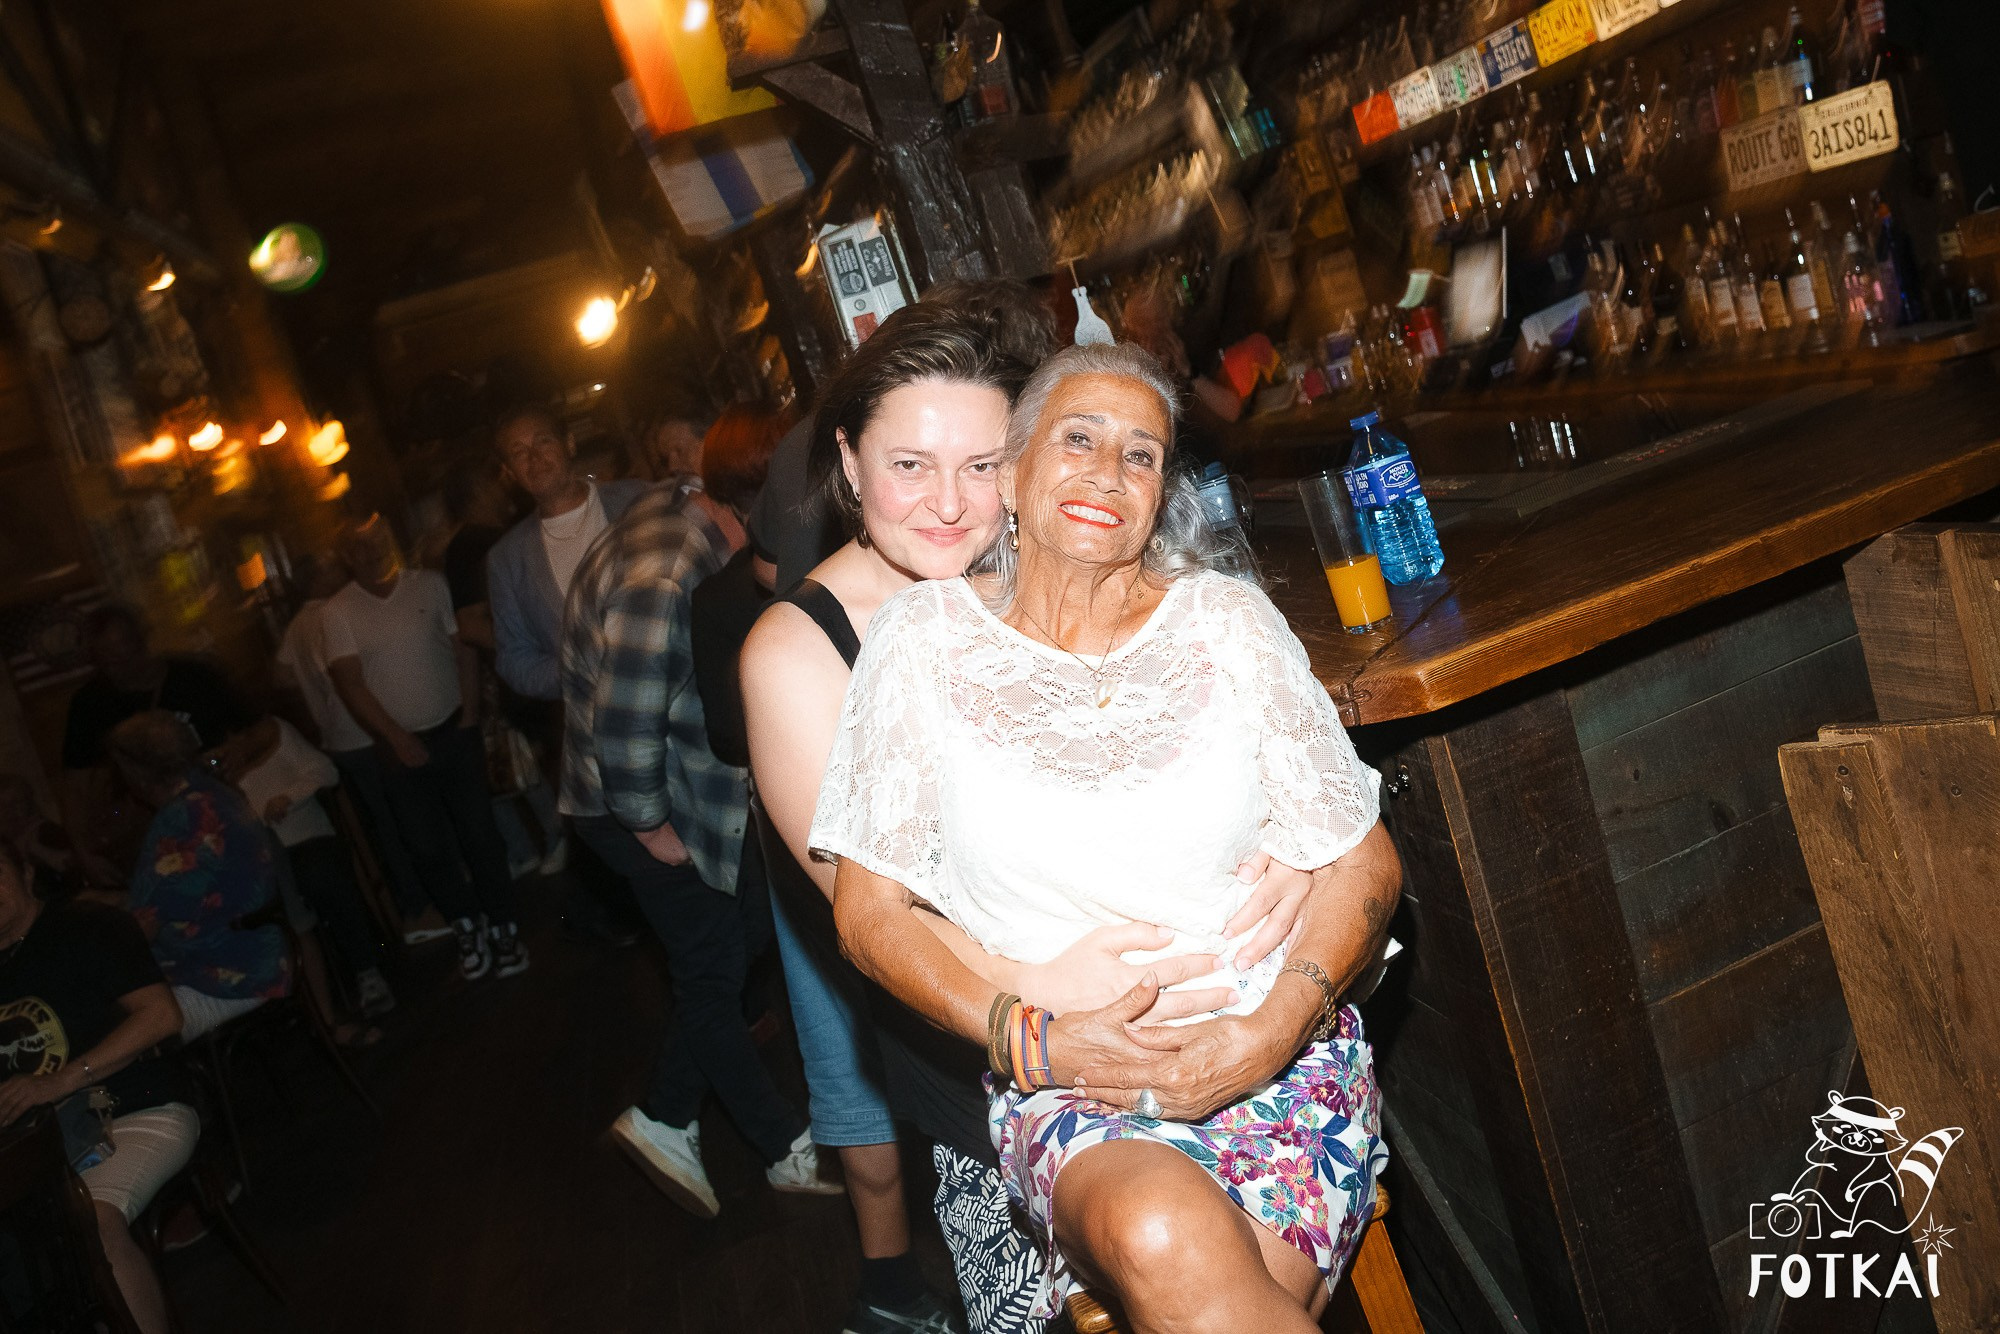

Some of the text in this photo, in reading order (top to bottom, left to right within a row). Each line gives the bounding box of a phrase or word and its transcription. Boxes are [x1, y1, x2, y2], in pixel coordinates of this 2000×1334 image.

[1727, 118, 1801, 175] ROUTE 66
[1809, 108, 1892, 160] 3AIS841
